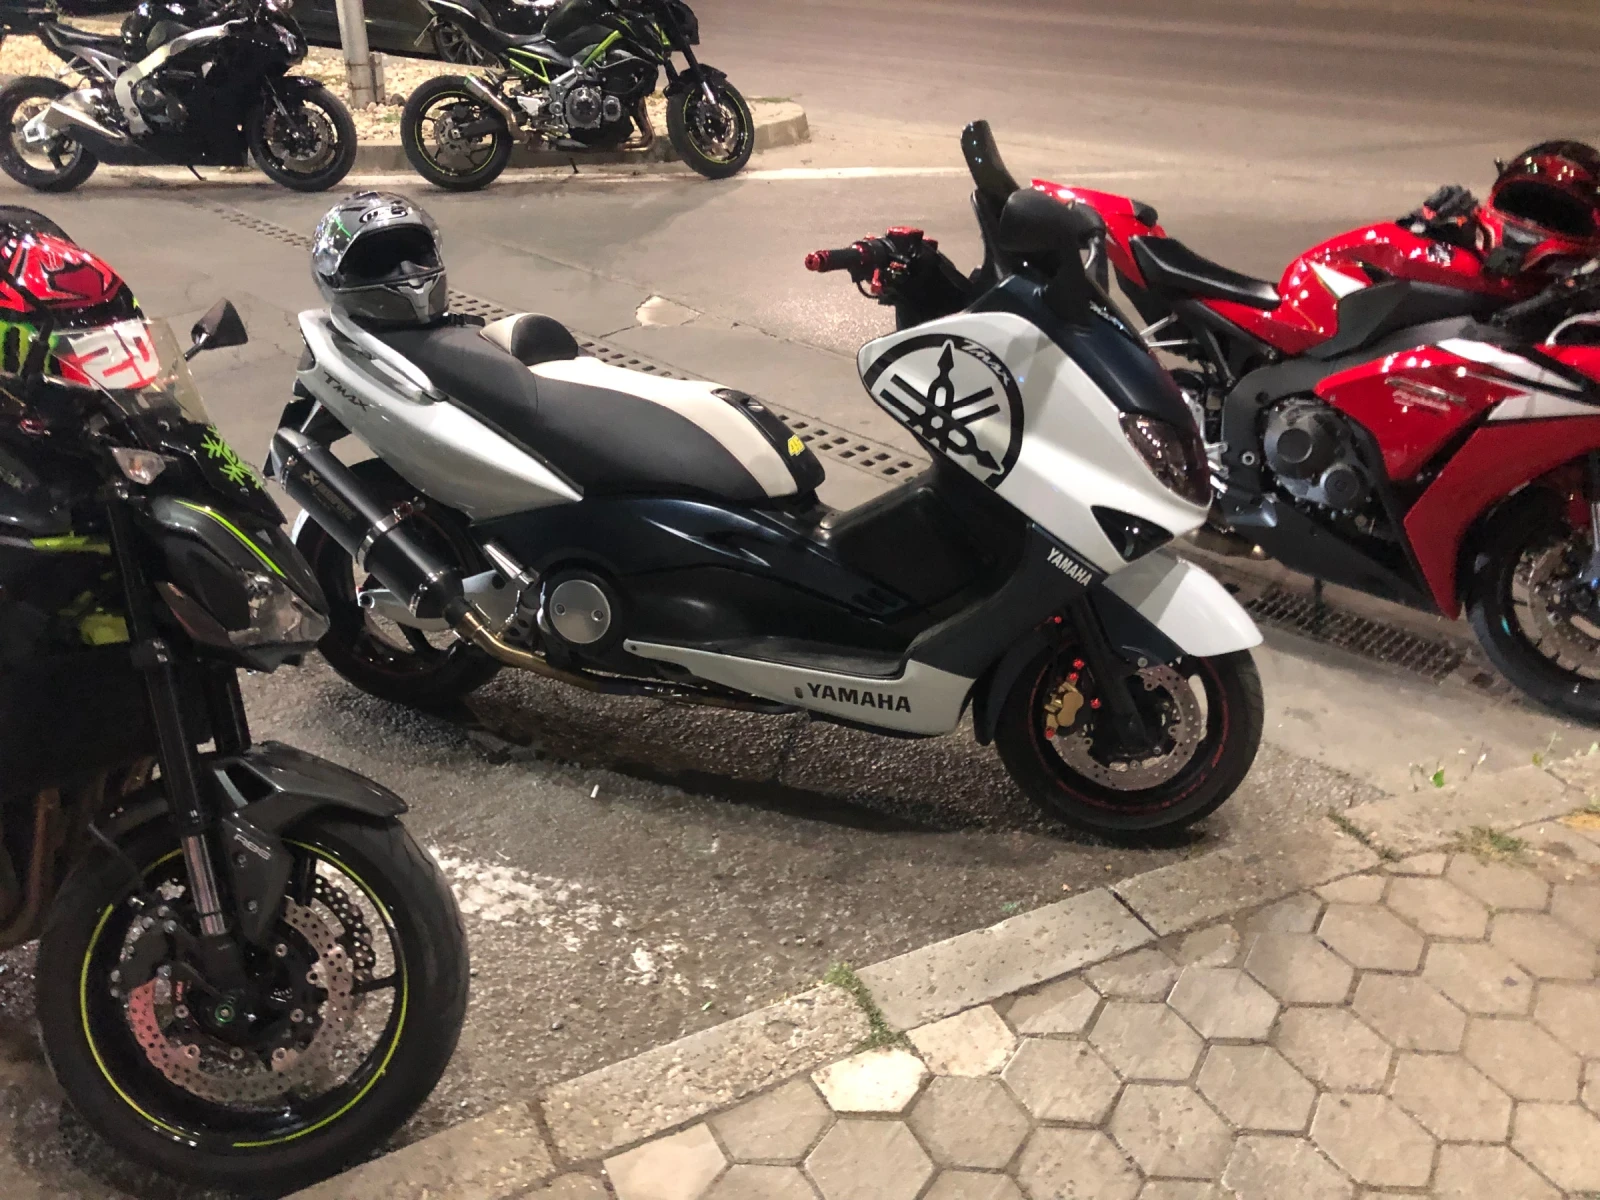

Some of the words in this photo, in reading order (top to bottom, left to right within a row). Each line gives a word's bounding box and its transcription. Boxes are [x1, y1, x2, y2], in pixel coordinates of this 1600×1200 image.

[1046, 547, 1092, 586] YAMAHA
[806, 682, 912, 713] YAMAHA
[234, 834, 271, 859] ABS
